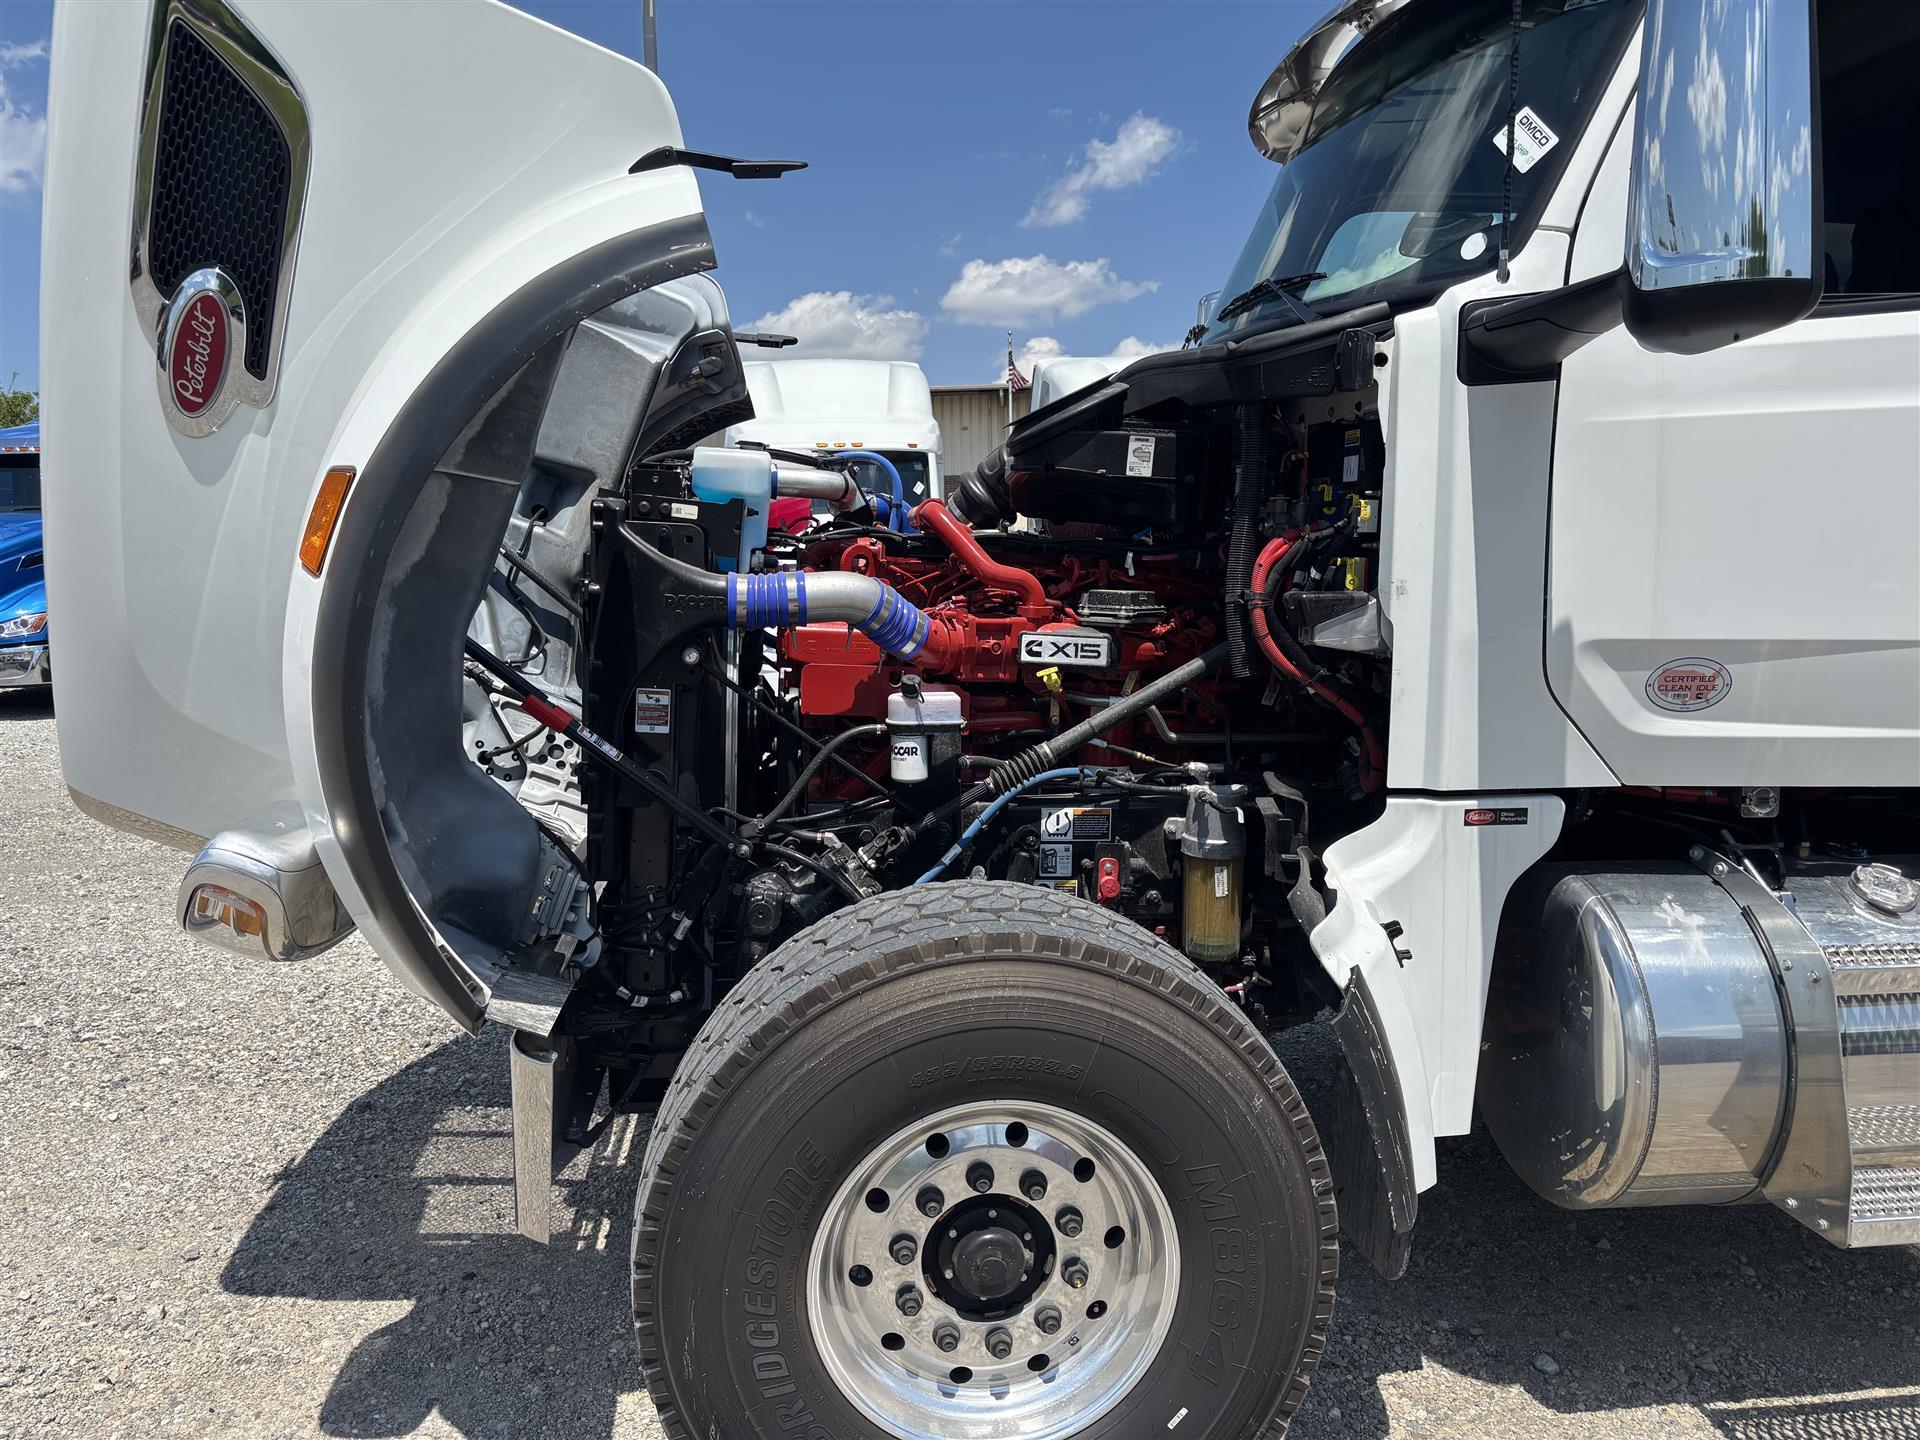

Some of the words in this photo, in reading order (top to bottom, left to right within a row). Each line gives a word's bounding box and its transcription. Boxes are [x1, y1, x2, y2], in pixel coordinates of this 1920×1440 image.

[1519, 115, 1550, 147] OMCO
[176, 302, 216, 403] Peterbilt
[663, 593, 727, 610] PACCAR
[1048, 641, 1102, 660] X15
[1657, 684, 1692, 692] CLEAN
[1695, 684, 1719, 692] IDLE
[1664, 675, 1716, 683] CERTIFIED
[890, 745, 919, 757] CCAR
[1184, 1163, 1248, 1387] M864
